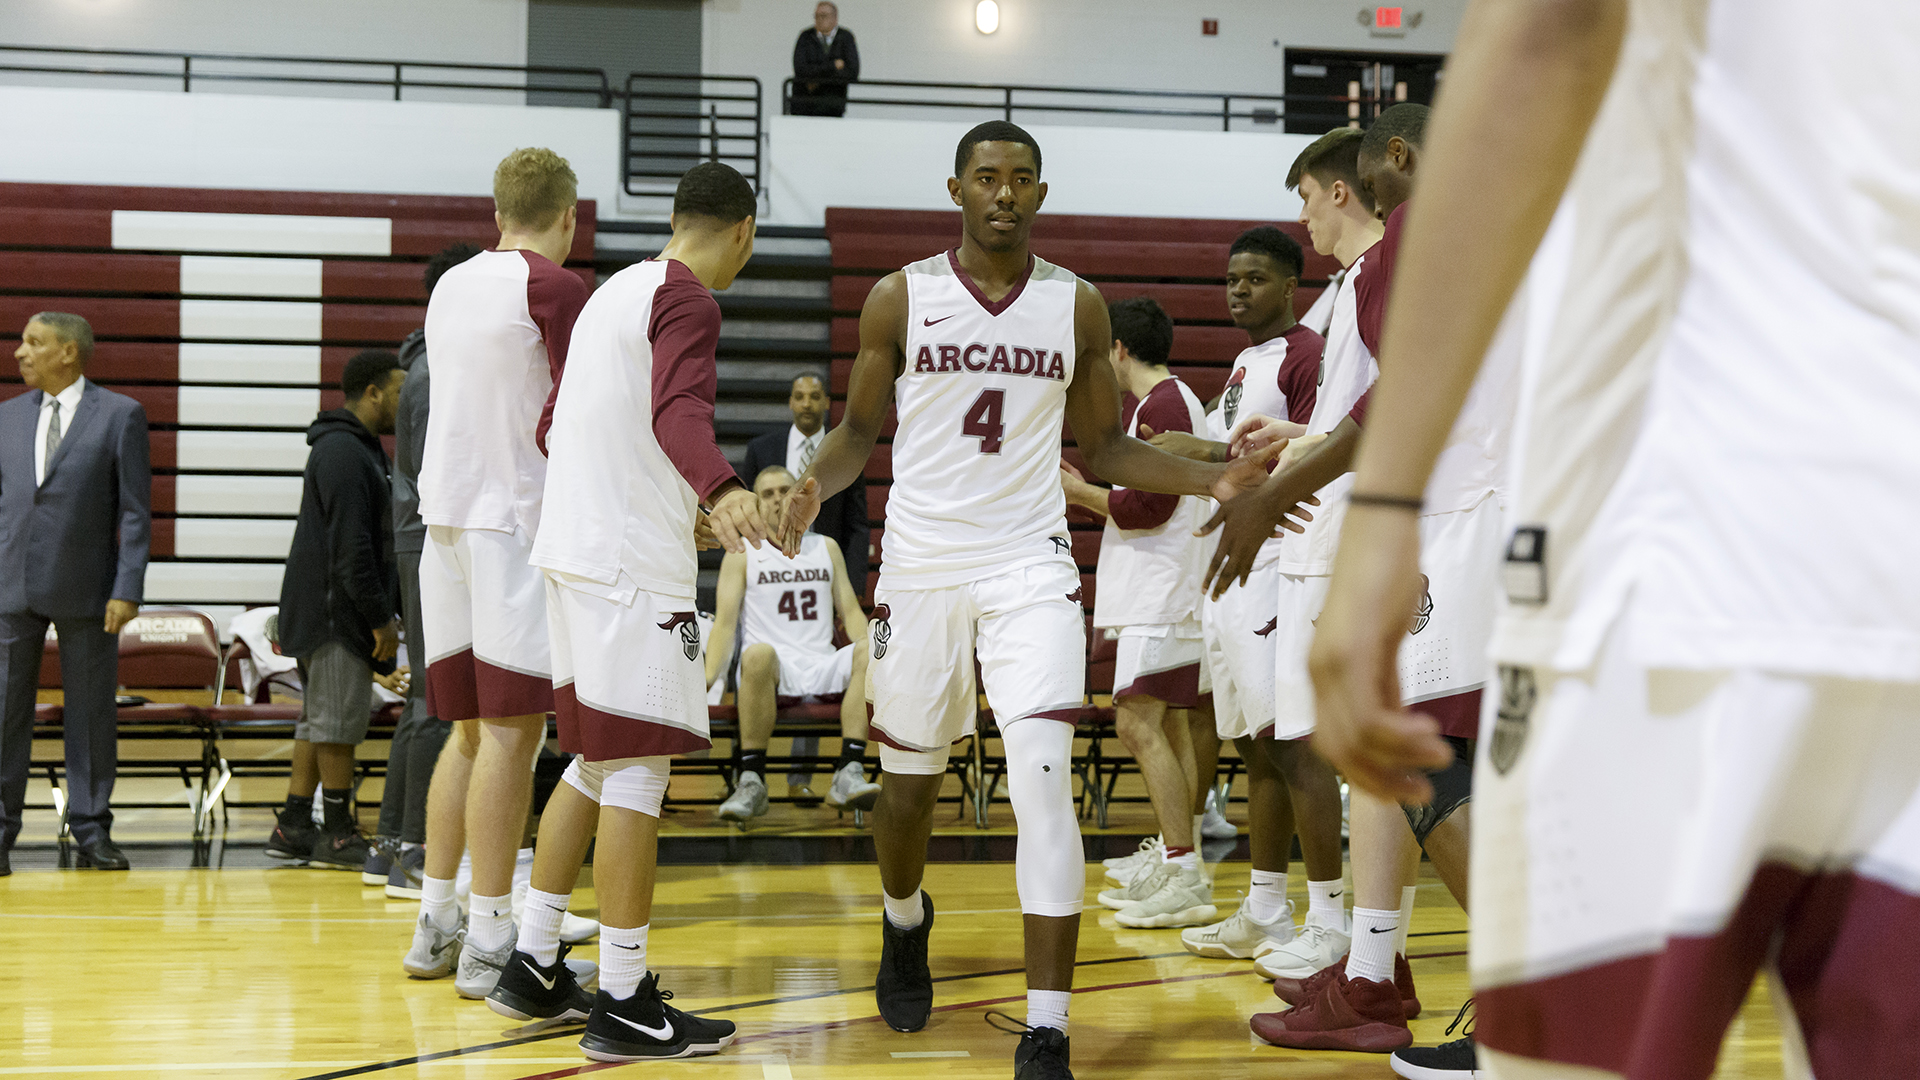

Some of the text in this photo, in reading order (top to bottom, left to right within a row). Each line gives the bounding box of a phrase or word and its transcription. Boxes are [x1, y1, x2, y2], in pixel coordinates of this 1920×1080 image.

[915, 342, 1066, 382] ARCADIA
[961, 387, 1006, 456] 4
[757, 568, 830, 585] ARCADIA
[778, 590, 818, 621] 42
[124, 616, 205, 634] ARCADIA
